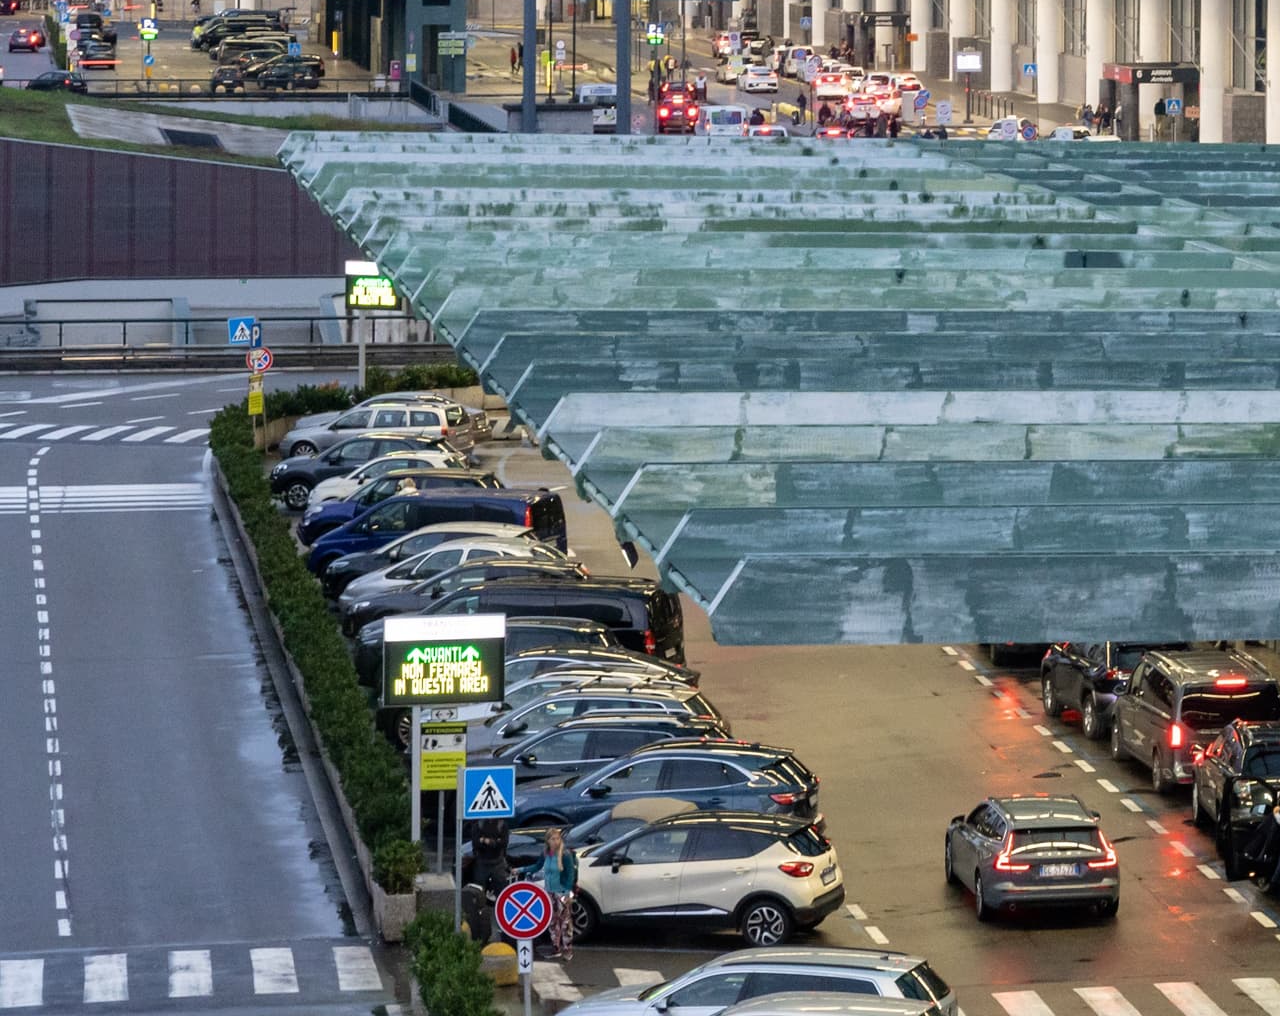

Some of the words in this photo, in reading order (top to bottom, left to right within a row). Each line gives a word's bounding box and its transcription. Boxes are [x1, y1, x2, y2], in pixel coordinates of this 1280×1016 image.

[253, 326, 260, 346] P
[424, 646, 462, 664] AVANTI
[402, 663, 424, 679] NON
[430, 660, 482, 678] FERMARSI
[394, 678, 406, 696] IN
[412, 676, 454, 695] QUESTA
[460, 675, 488, 693] AREA
